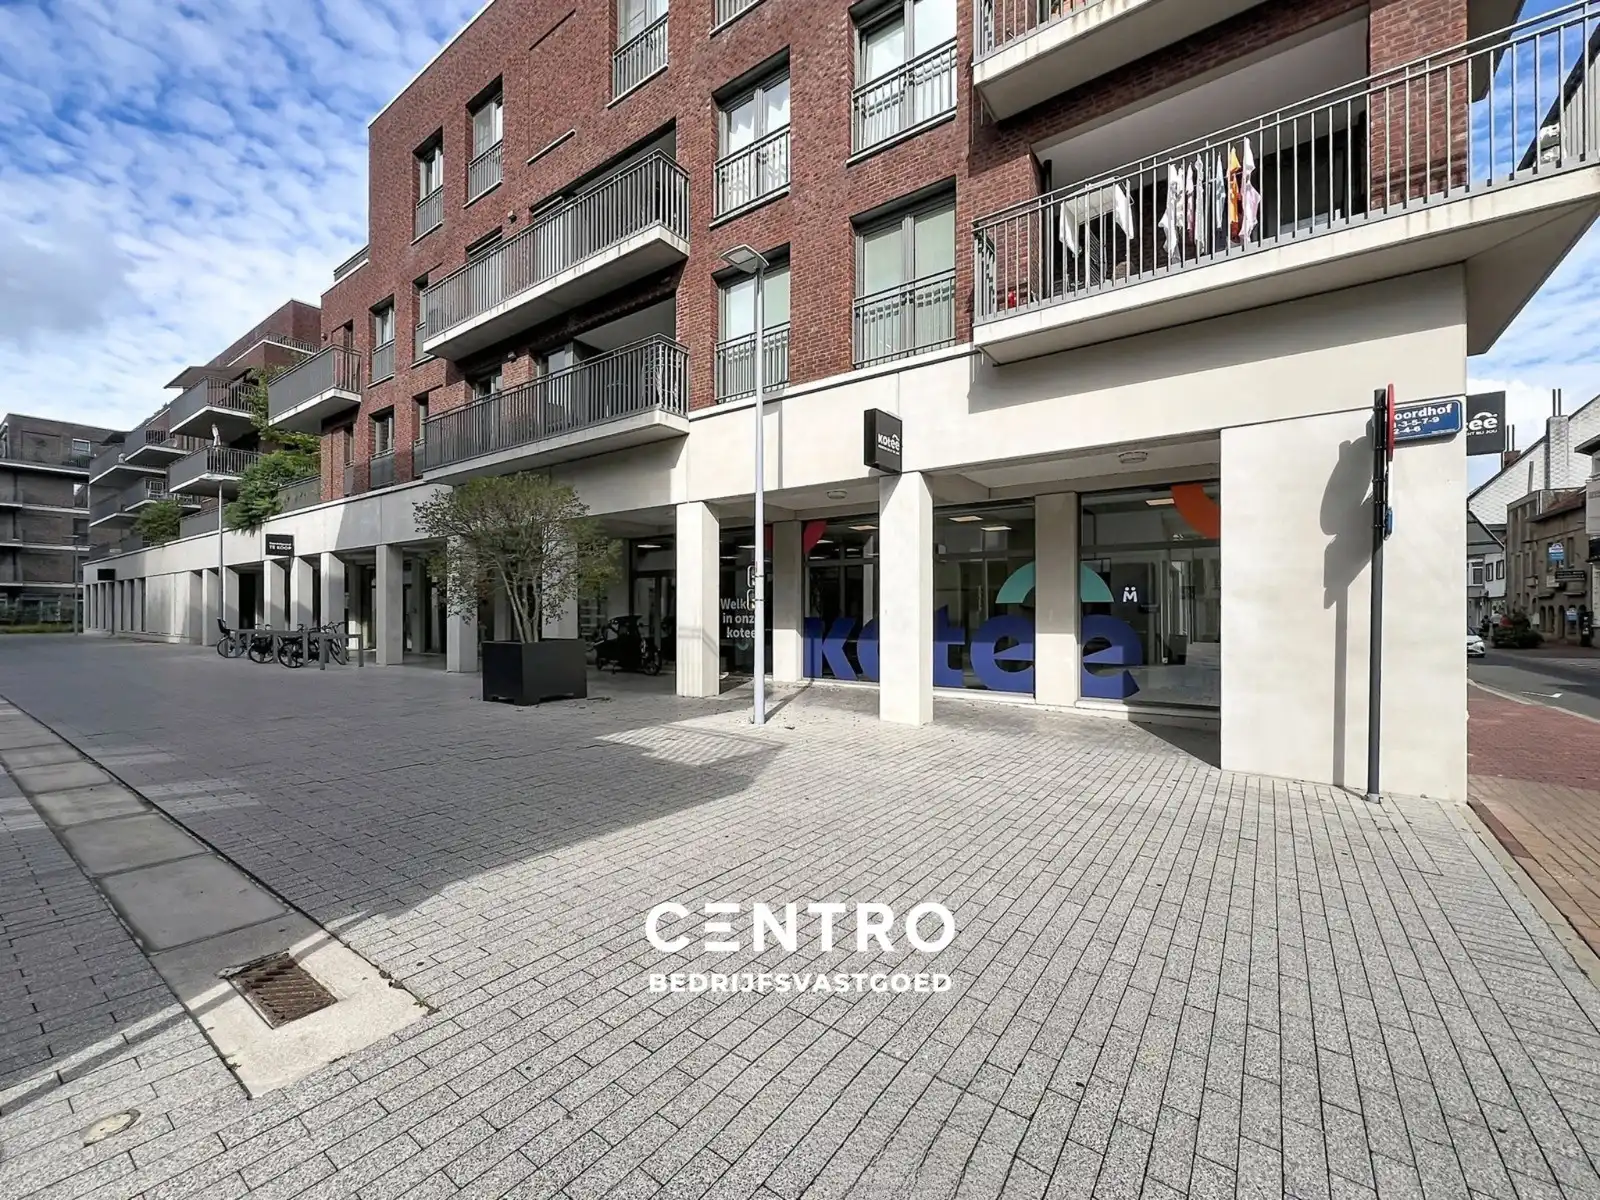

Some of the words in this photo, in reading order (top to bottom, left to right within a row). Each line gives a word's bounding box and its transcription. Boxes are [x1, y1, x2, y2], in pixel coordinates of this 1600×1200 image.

[1394, 403, 1453, 420] oordhof
[720, 598, 747, 610] Welk
[722, 612, 733, 624] in
[734, 614, 755, 624] onz
[726, 626, 756, 638] kotee
